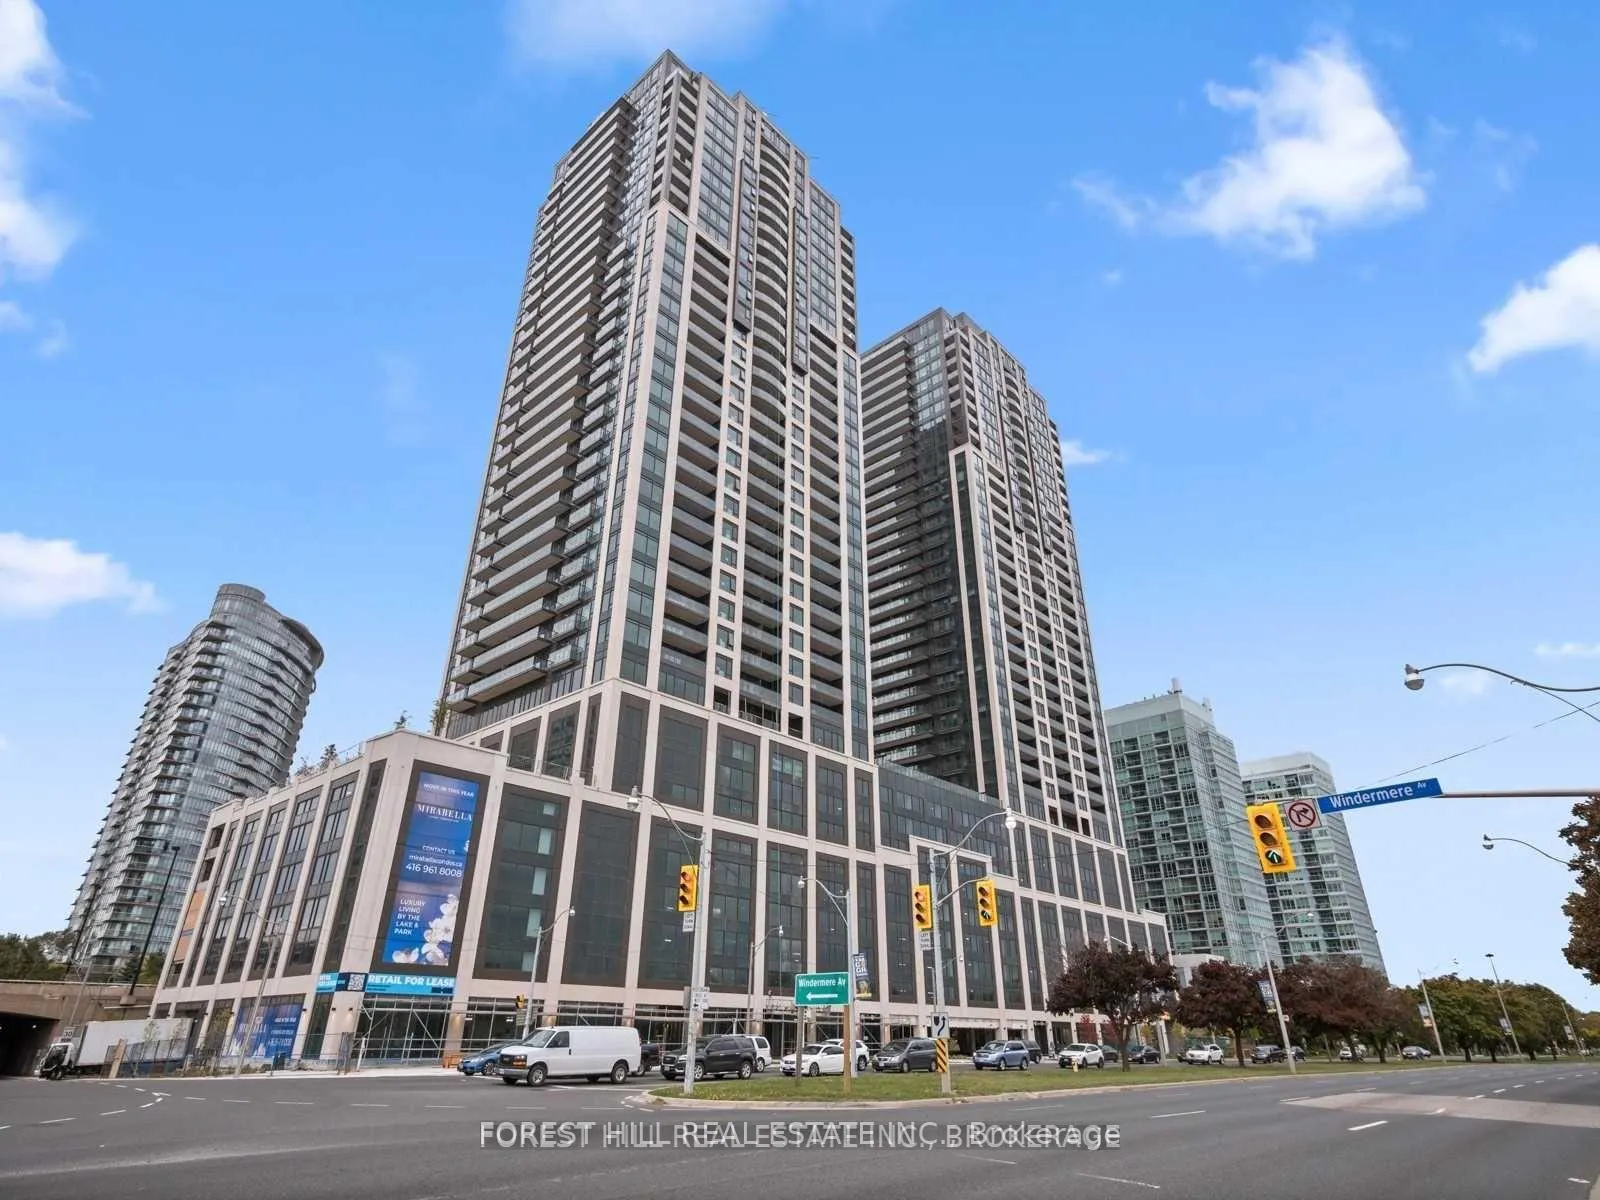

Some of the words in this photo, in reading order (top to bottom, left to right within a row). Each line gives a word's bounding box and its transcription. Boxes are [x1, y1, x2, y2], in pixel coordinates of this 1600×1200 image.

[461, 789, 475, 798] YEAR
[1329, 786, 1413, 807] Windermere
[417, 803, 473, 822] MIRABELLA
[422, 845, 447, 855] CONTACT
[405, 862, 421, 872] 416
[422, 865, 438, 875] 961
[438, 867, 463, 878] 8008
[400, 898, 426, 907] LUXURY
[398, 906, 421, 914] LIVING
[394, 928, 413, 936] PARK
[368, 974, 402, 985] RETAIL
[404, 976, 425, 986] FOR
[427, 977, 455, 987] LEASE
[798, 978, 836, 987] Windermere
[837, 977, 846, 986] Av
